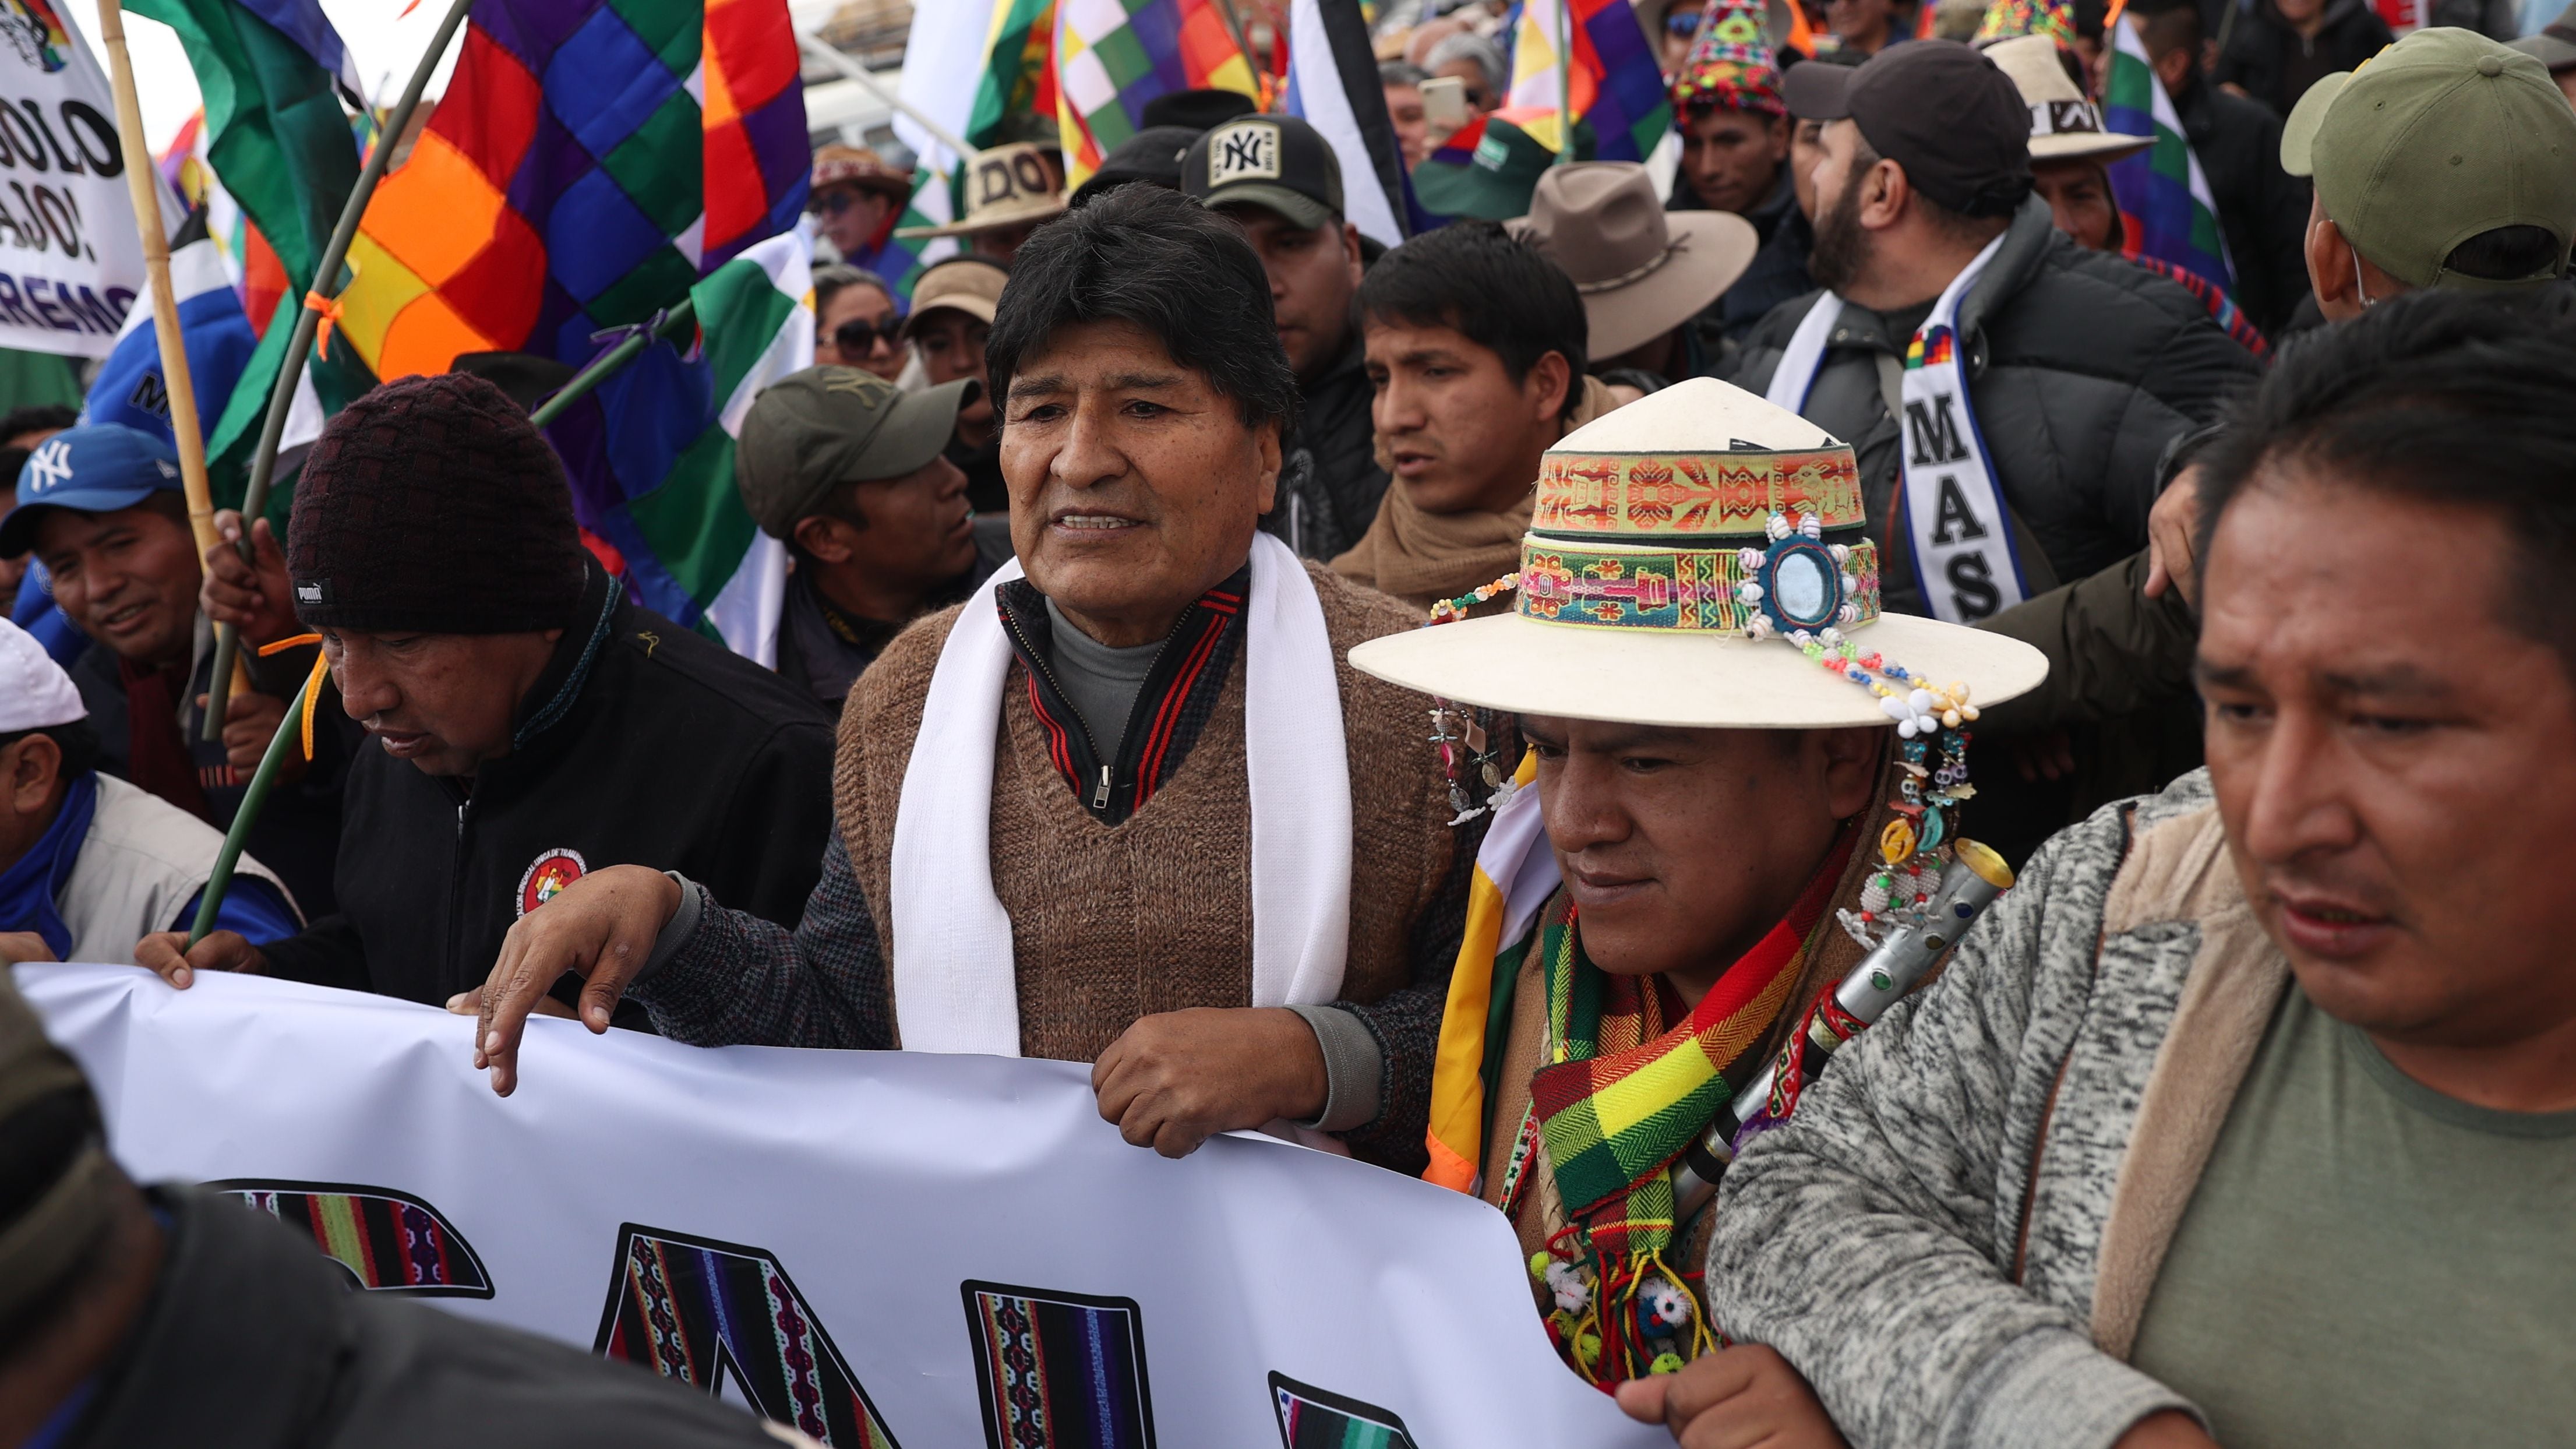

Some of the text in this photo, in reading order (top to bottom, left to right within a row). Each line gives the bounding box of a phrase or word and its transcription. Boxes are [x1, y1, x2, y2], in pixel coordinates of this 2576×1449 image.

[0, 98, 124, 177] OLO
[30, 440, 74, 493] NY
[1905, 393, 2000, 623] MAS
[298, 587, 322, 600] PUMA
